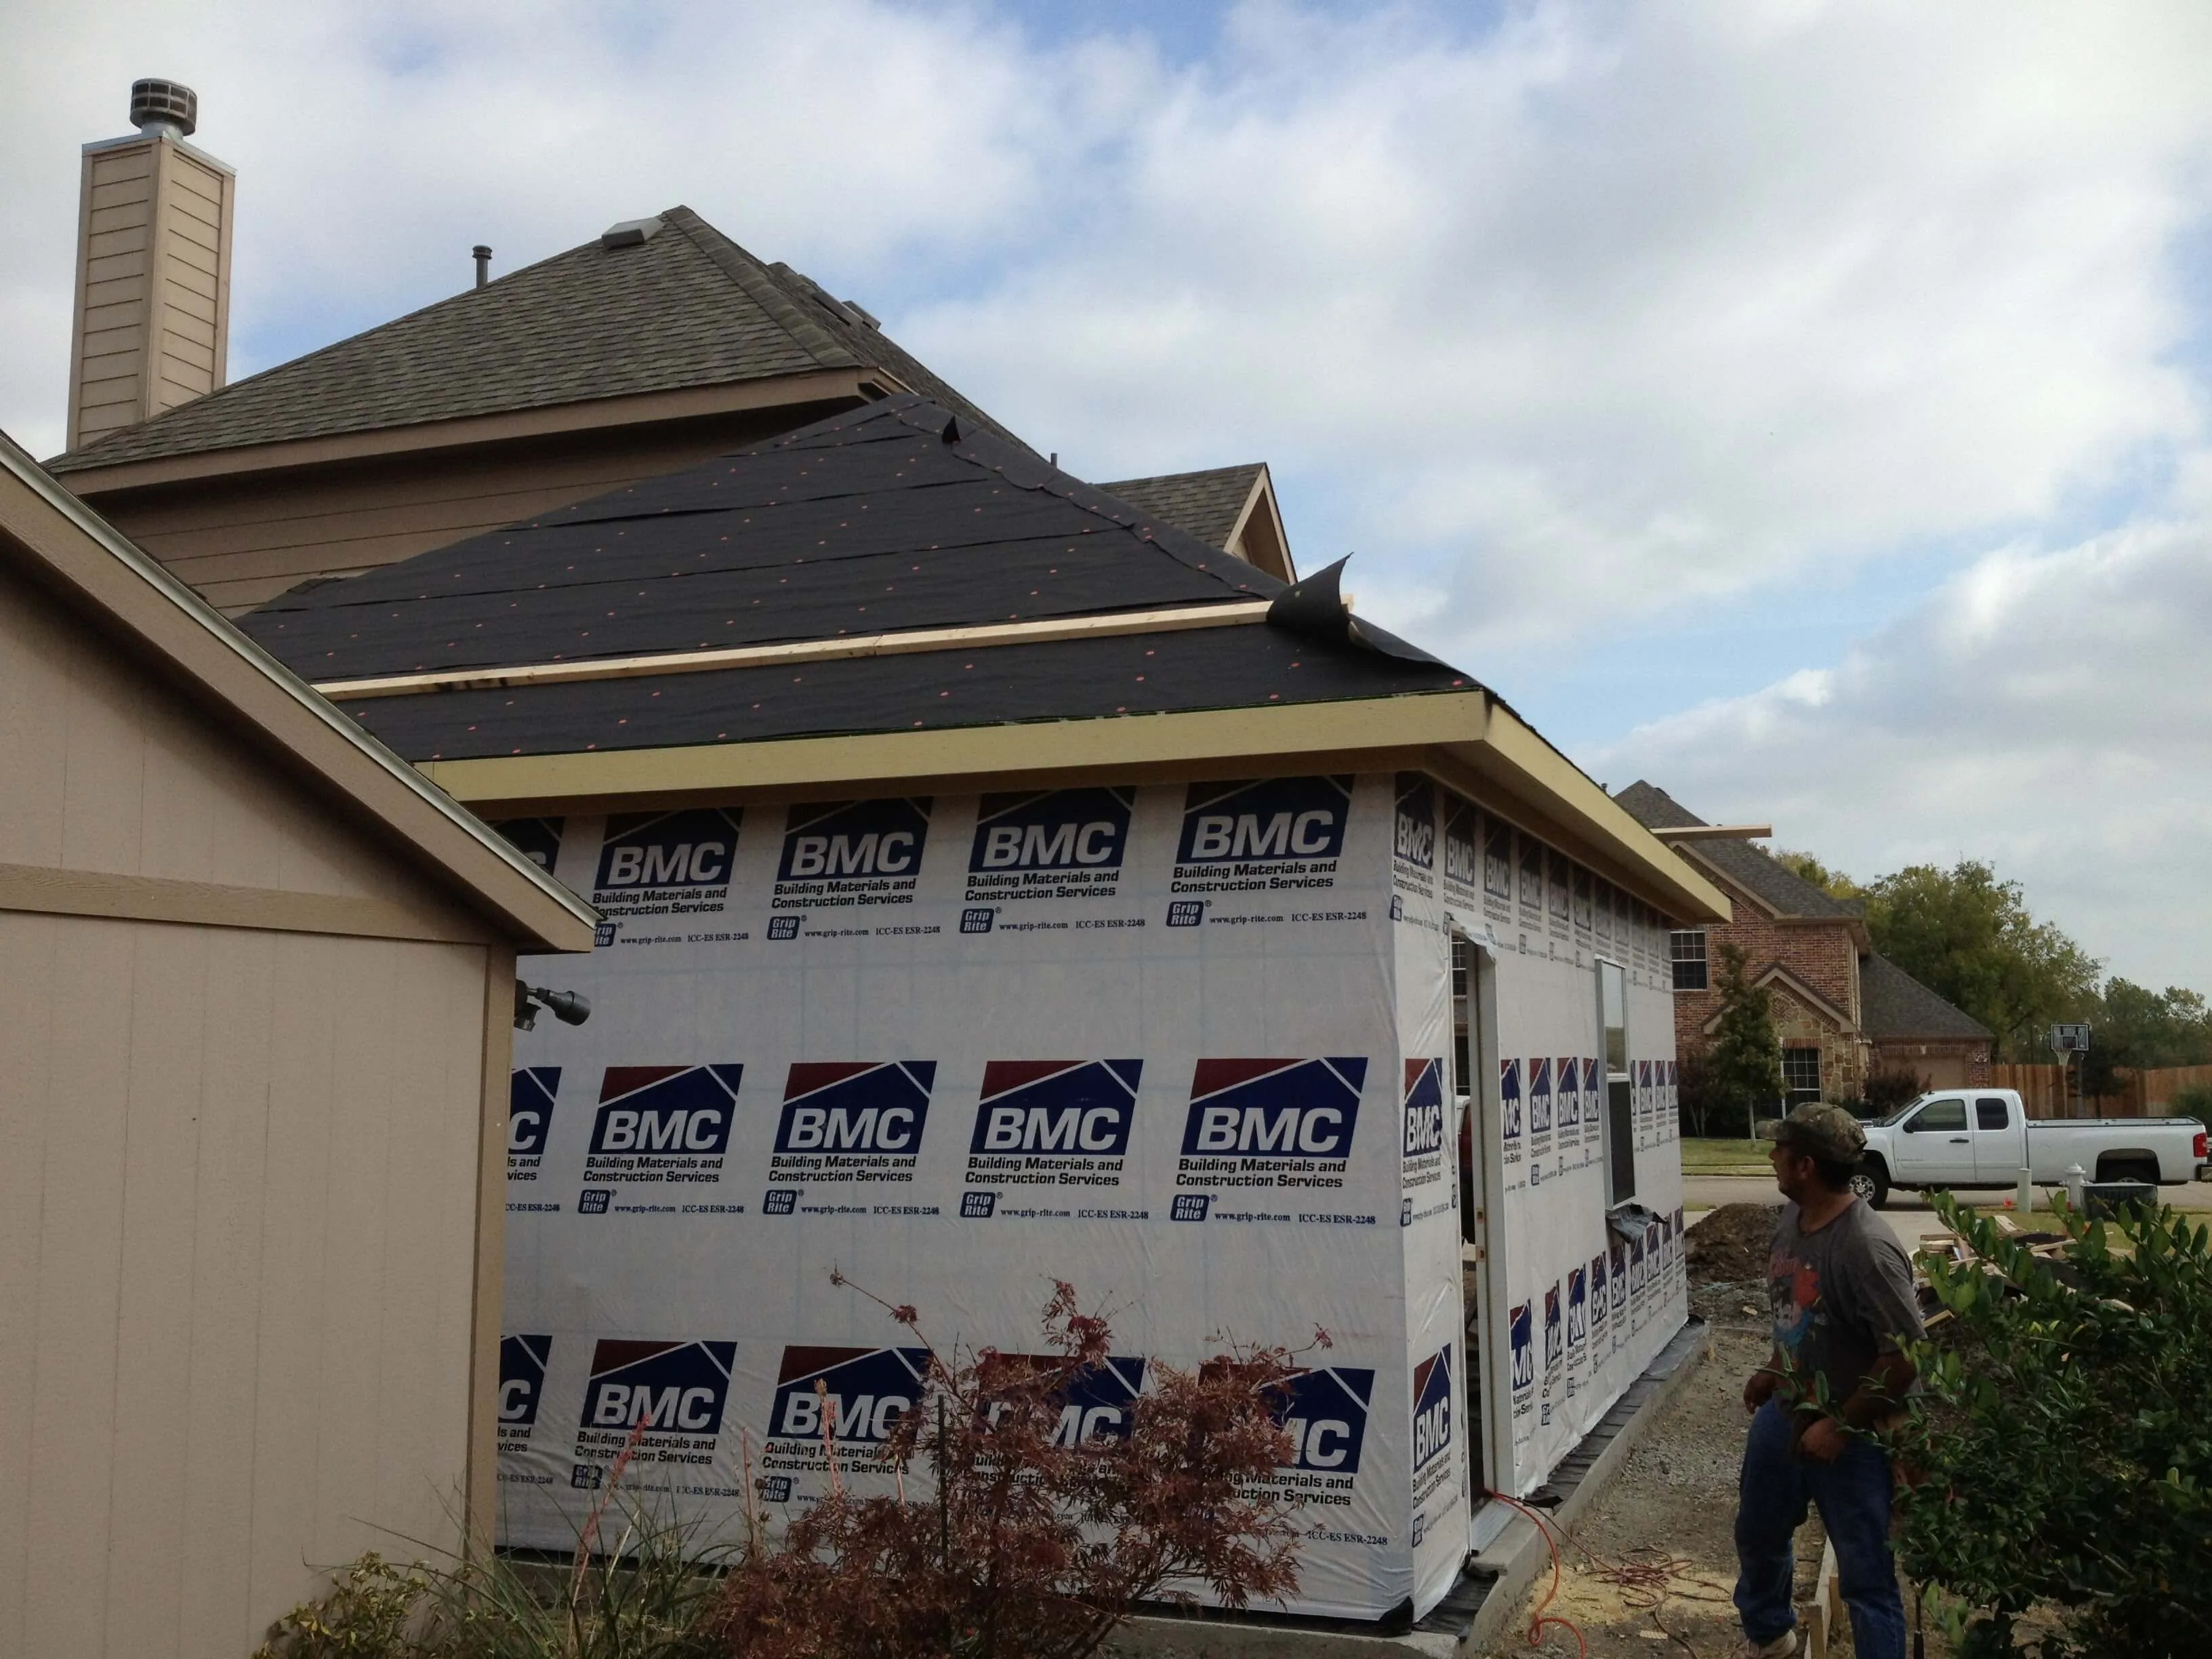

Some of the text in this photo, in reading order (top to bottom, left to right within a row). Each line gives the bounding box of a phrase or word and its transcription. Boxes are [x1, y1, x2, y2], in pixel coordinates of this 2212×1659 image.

[1191, 810, 1334, 859] BMC
[1397, 813, 1433, 864] BMC
[983, 821, 1115, 867] BMC
[790, 832, 914, 876] BMC
[1447, 835, 1473, 882] BMC
[607, 841, 724, 885] BMC
[1174, 860, 1337, 879] Building Materials and
[967, 870, 1120, 887] Building Materials and
[1486, 855, 1509, 896] BMC
[774, 879, 916, 896] Building Materials and
[1171, 876, 1334, 893] Construction Services
[593, 886, 727, 904] Building Materials and
[965, 885, 1116, 901] Construction Services
[672, 901, 724, 914] Services
[772, 893, 913, 909] Construction Services
[1172, 903, 1199, 915] Grip
[773, 918, 796, 928] Grip
[965, 911, 989, 922] Grip
[1171, 915, 1196, 926] Rite
[1209, 912, 1366, 925] www.grip-rite.com ICC-ES ESR-2248
[596, 926, 613, 935] rip
[804, 926, 941, 938] www.grip-rite.com ICC-ES ESR-2248
[964, 922, 987, 931] Rite
[999, 919, 1145, 931] www.grip-rite.com ICC-ES ESR-2248
[595, 936, 609, 945] ite
[688, 933, 714, 943] ICC-ES
[771, 929, 794, 939] Rite
[1532, 1094, 1550, 1129] BMC
[1559, 1090, 1578, 1124] BMC
[1584, 1090, 1598, 1119] BMC
[1502, 1097, 1519, 1136] MC
[602, 1109, 721, 1150] BMC
[787, 1107, 914, 1149] BMC
[984, 1107, 1120, 1151] BMC
[1196, 1107, 1343, 1153] BMC
[1406, 1105, 1440, 1152] BMC
[519, 1156, 541, 1167] and
[586, 1156, 724, 1170] Building Materials and
[771, 1155, 916, 1170] Building Materials and
[968, 1157, 1123, 1171] Building Materials and
[1179, 1158, 1347, 1173] Building Materials and
[508, 1170, 537, 1181] vices
[583, 1170, 719, 1183] Construction Services
[769, 1170, 913, 1182] Construction Services
[965, 1171, 1119, 1186] Construction Services
[1176, 1173, 1343, 1187] Construction Services
[583, 1191, 606, 1202] Grip
[769, 1192, 792, 1202] Grip
[966, 1194, 991, 1206] Grip
[1176, 1196, 1204, 1208] Grip
[506, 1203, 560, 1212] CC-ES ESR-2248
[582, 1202, 603, 1212] Rite
[614, 1205, 744, 1214] www.grip-rite.com ICC-ES ESR-2248
[767, 1202, 790, 1213] Rite
[801, 1206, 939, 1215] www.grip-rite.com ICC-ES ESR-2248
[964, 1206, 989, 1216] Rite
[1000, 1209, 1149, 1219] www.grip-rite.com ICC-ES ESR-2248
[1175, 1208, 1201, 1220] Rite
[1214, 1212, 1376, 1225] www.grip-rite.com ICC-ES ESR-2248
[1511, 1341, 1532, 1386] MC
[593, 1384, 714, 1429] BMC
[781, 1392, 910, 1439] BMC
[510, 1427, 531, 1438] and
[1416, 1395, 1448, 1467] BMC
[498, 1439, 527, 1452] vices
[577, 1431, 716, 1450] Building aterials and
[575, 1445, 713, 1465] Constrtion Services
[765, 1441, 815, 1457] Building
[762, 1456, 847, 1473] Constructn
[1326, 1477, 1353, 1490] and
[1344, 1533, 1388, 1545] ESR-2248
